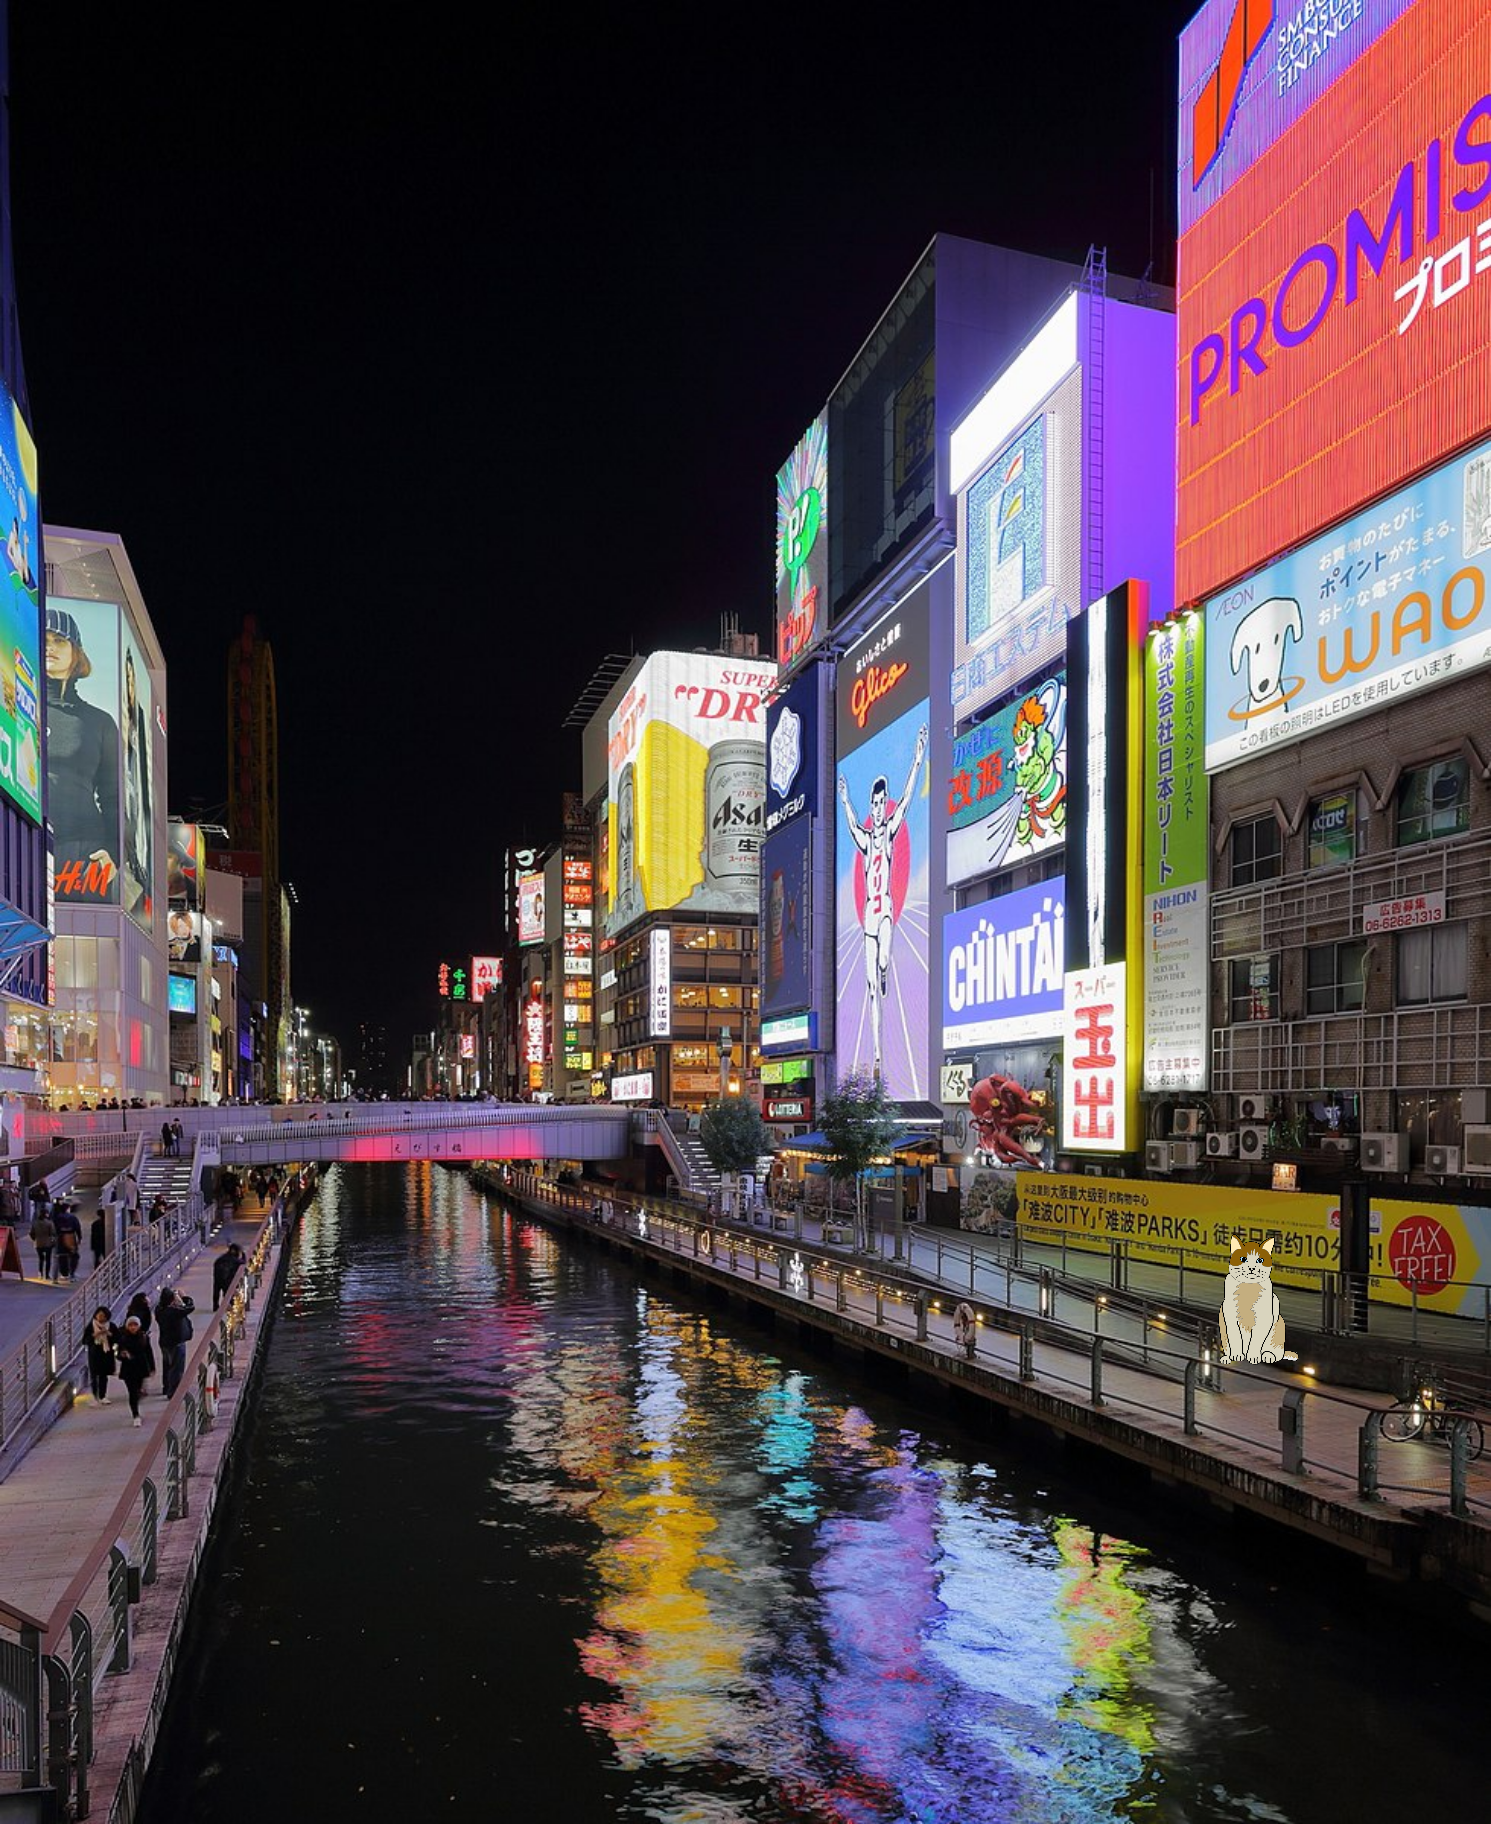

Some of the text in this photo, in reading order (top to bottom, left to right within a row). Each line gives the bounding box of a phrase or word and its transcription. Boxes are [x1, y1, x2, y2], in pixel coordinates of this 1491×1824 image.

[851, 661, 910, 729] Glico
[1157, 633, 1175, 884] 株式会社日本リート
[738, 838, 759, 853] 生
[55, 859, 112, 898] H&M
[872, 849, 884, 916] グリコ
[1154, 889, 1197, 911] NIHON
[1380, 897, 1426, 916] 広告募集
[949, 897, 1065, 1012] CHINTAI
[1074, 974, 1117, 1000] スーパー
[1072, 1002, 1117, 1140] 玉出
[1398, 1224, 1443, 1256] TAX
[1394, 1253, 1454, 1284] FREE!
